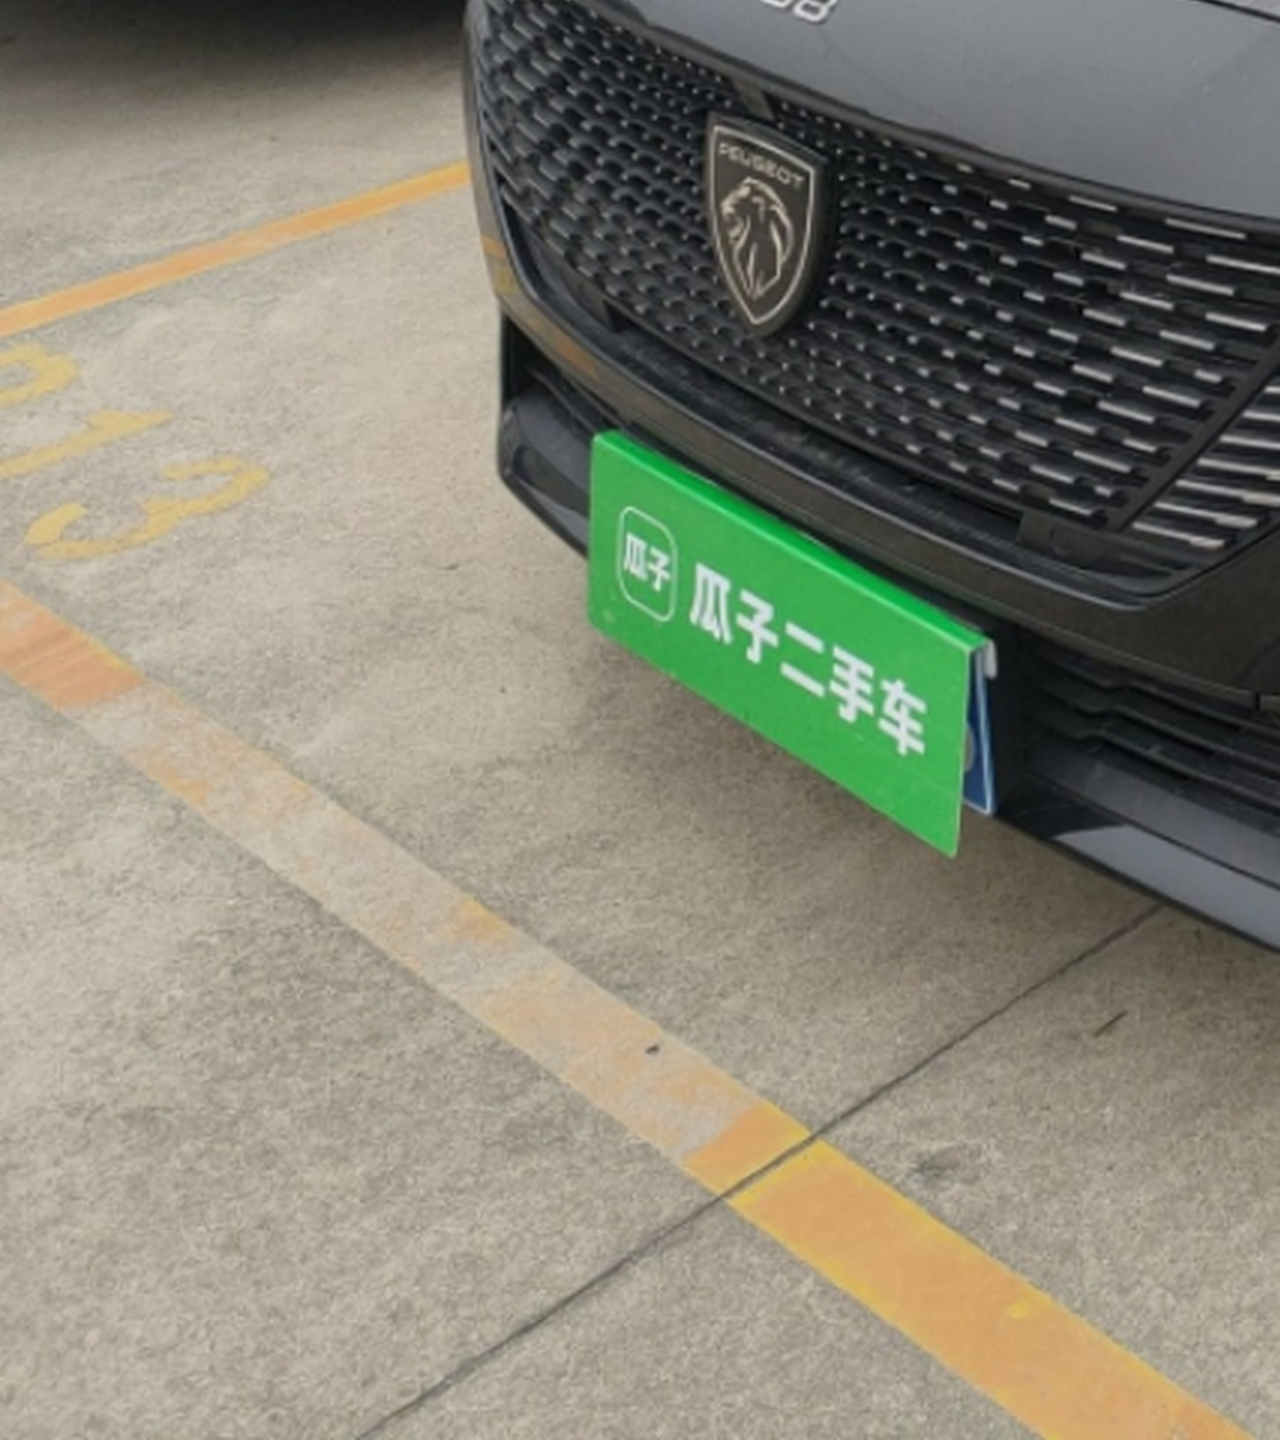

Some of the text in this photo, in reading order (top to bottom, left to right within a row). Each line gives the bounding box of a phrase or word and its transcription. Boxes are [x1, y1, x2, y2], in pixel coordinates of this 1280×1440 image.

[719, 142, 804, 187] PEUGEOT
[623, 533, 672, 591] 瓜子
[689, 563, 926, 755] 瓜子二手车
